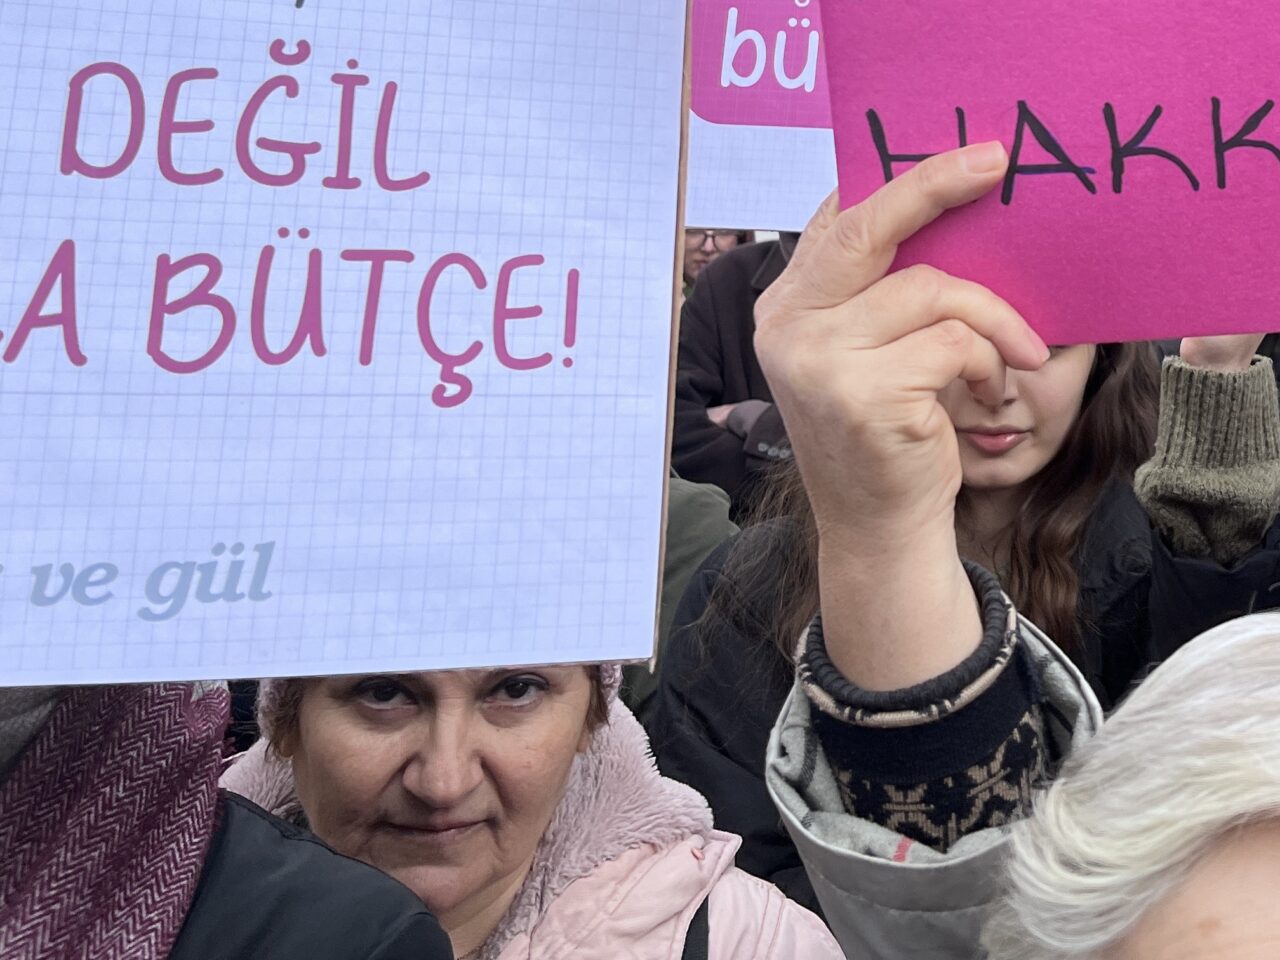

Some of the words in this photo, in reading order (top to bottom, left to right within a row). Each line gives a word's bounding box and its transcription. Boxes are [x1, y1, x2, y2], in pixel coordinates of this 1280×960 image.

[59, 39, 431, 193] DEĞİL
[0, 238, 88, 368] A
[145, 227, 581, 409] BÜTÇE!
[30, 560, 119, 608] ve
[136, 540, 277, 623] gül
